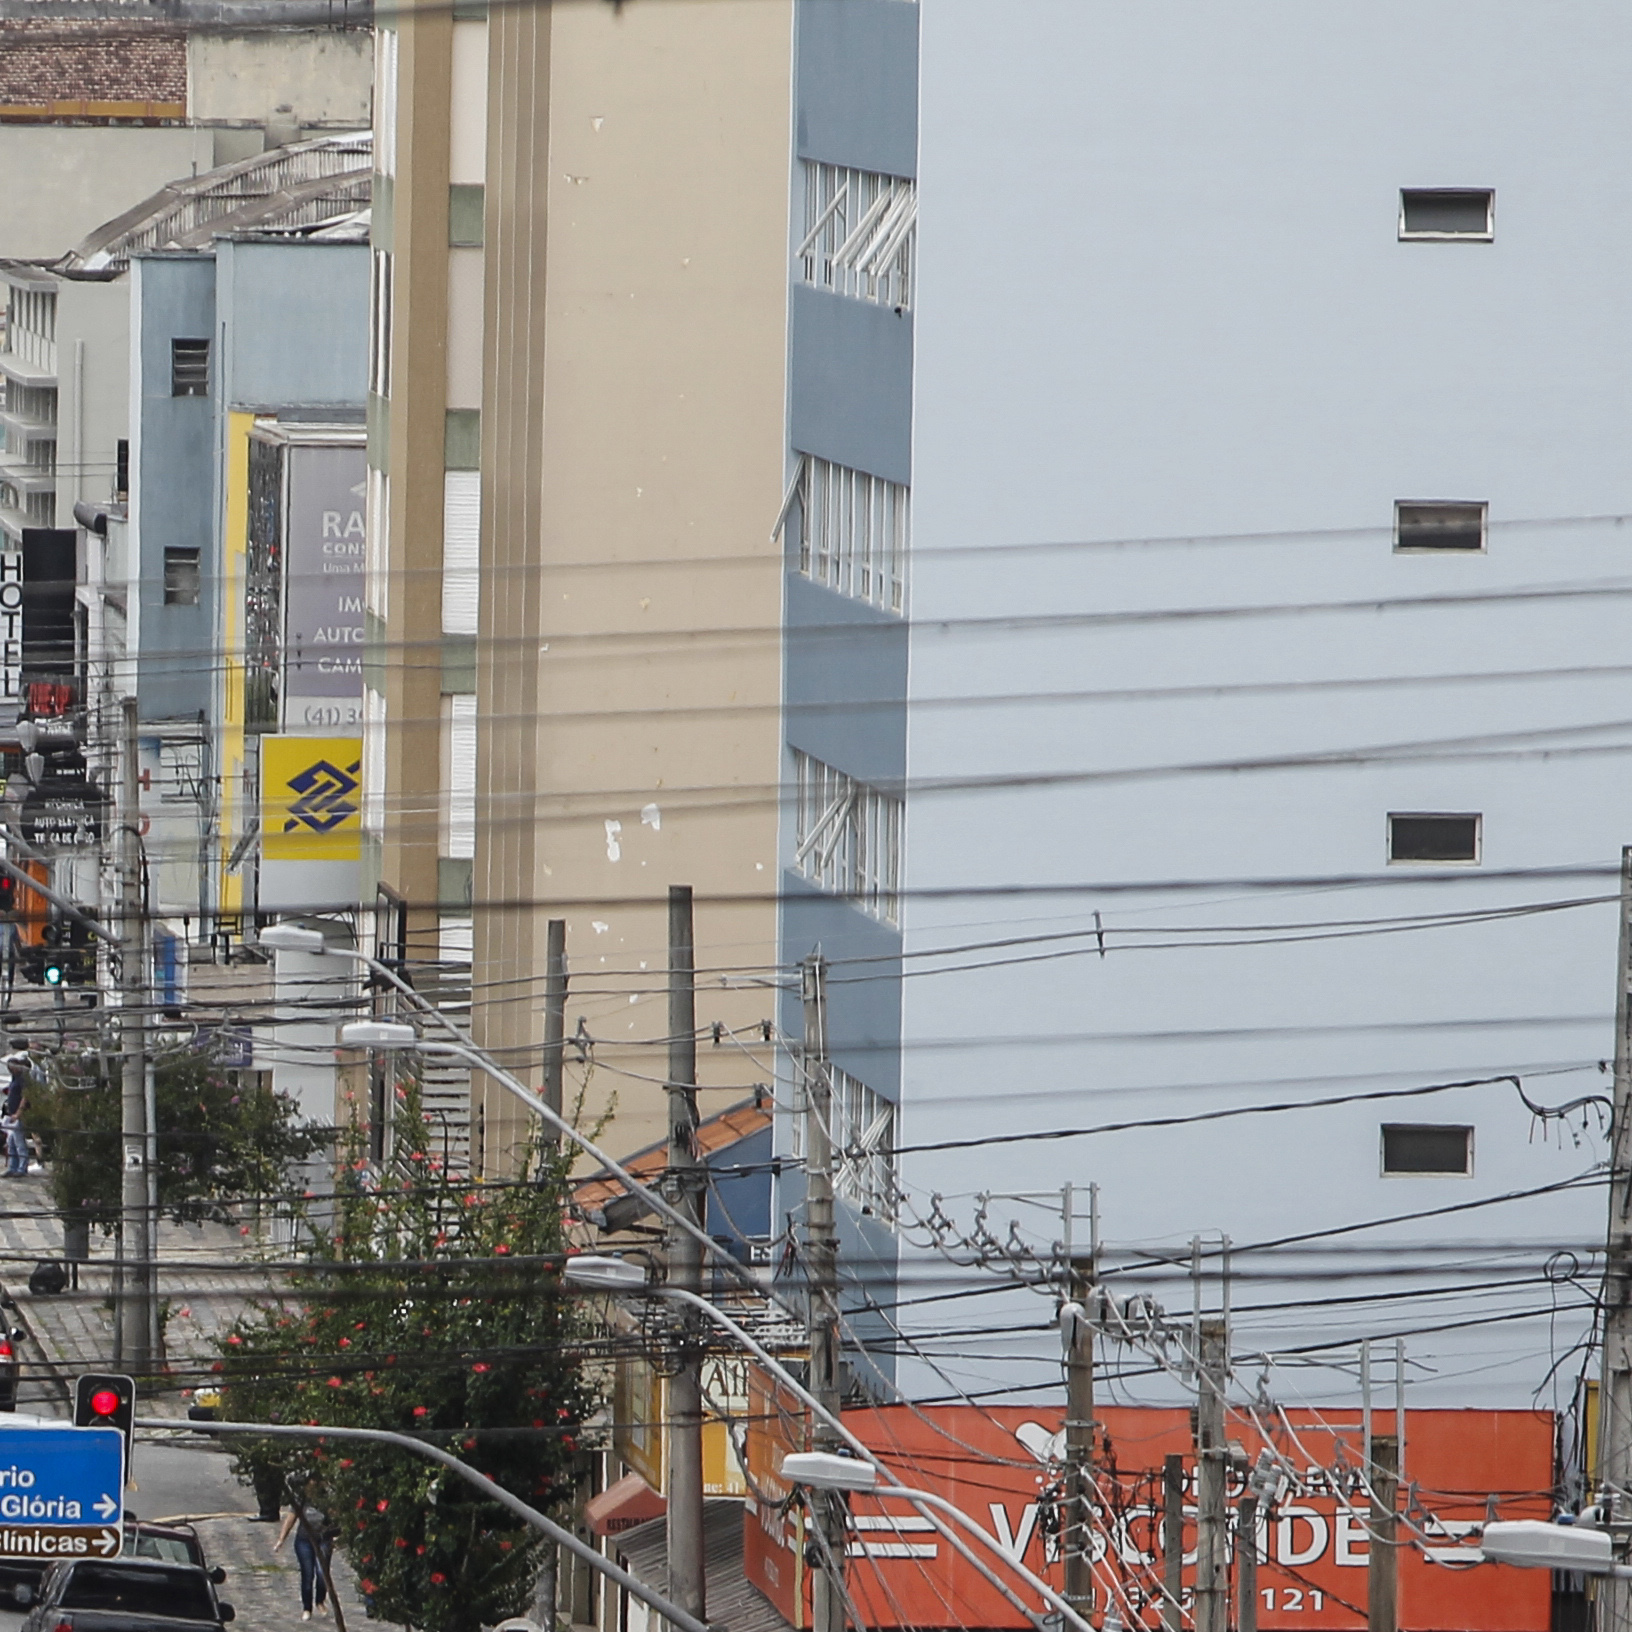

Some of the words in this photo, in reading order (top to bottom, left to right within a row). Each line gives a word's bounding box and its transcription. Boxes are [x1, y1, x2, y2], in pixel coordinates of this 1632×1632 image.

[322, 542, 365, 555] CON
[323, 562, 350, 574] Uma
[338, 596, 365, 613] IM
[0, 554, 24, 697] HOTEL
[304, 704, 341, 726] (41)
[345, 708, 364, 726] 3
[0, 1493, 82, 1519] Glória
[1259, 1588, 1325, 1611] 121
